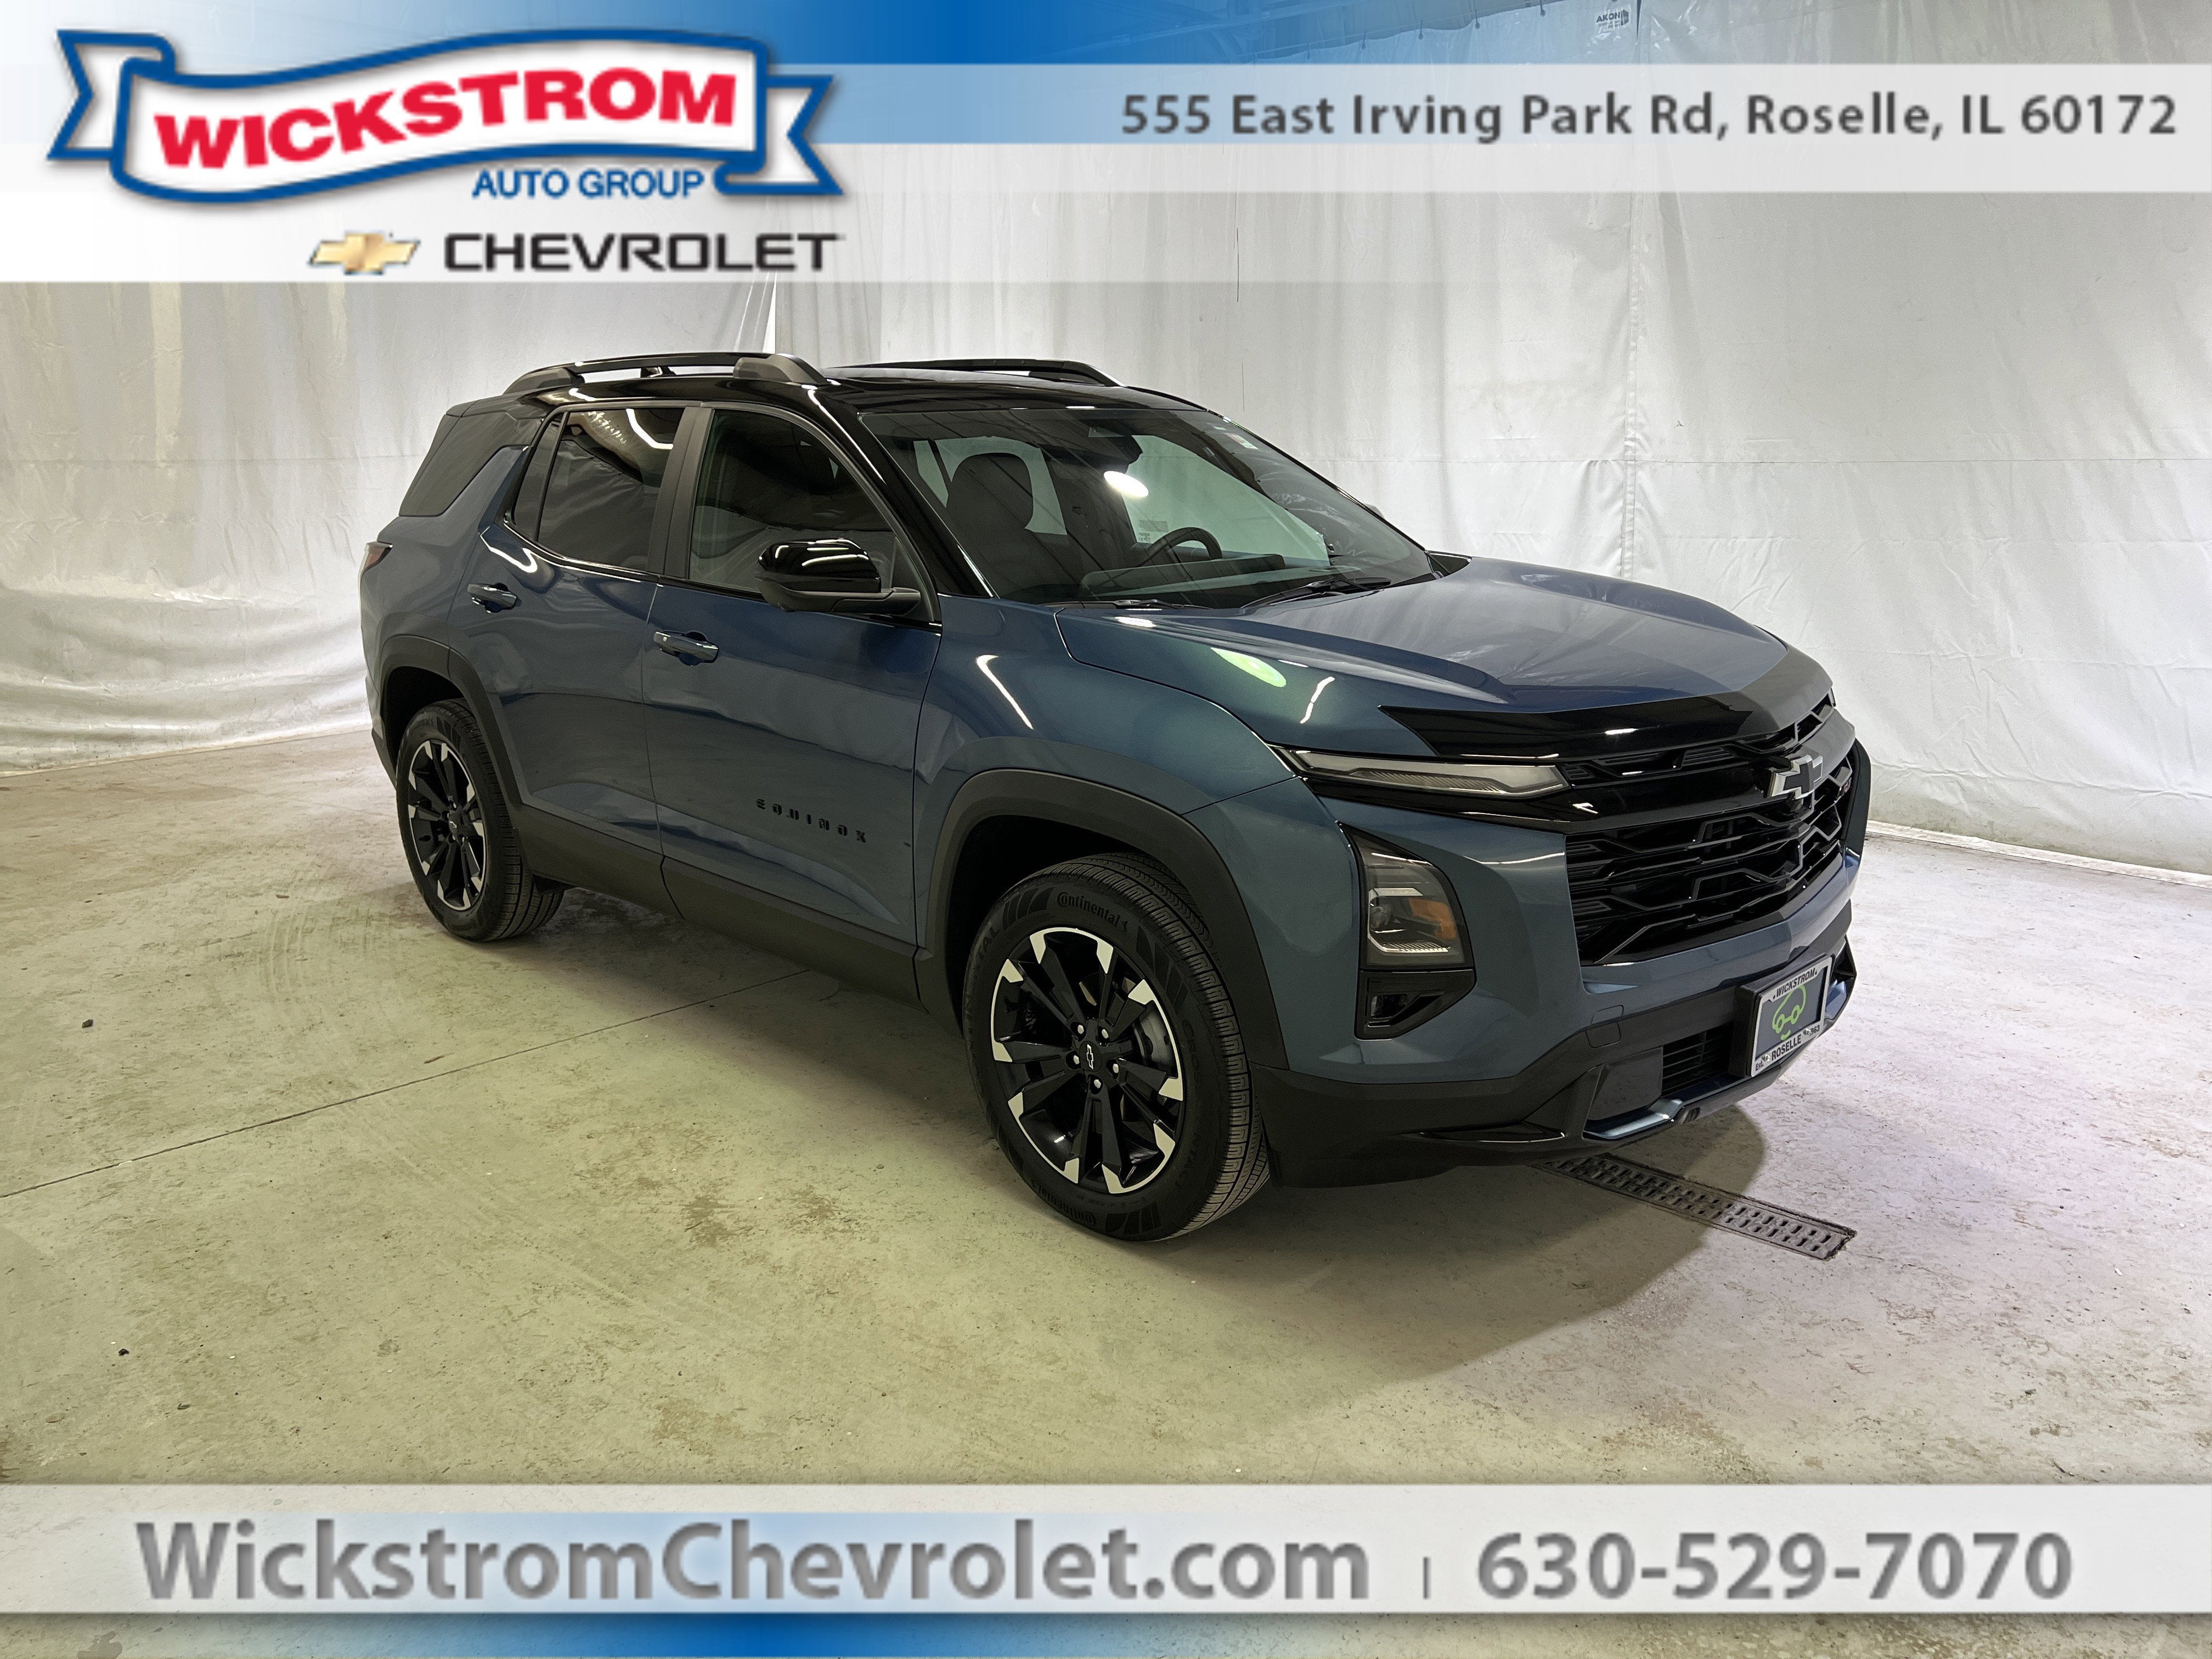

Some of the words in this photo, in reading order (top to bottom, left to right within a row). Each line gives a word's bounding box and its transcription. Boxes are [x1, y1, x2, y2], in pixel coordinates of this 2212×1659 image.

[757, 798, 867, 843] EQUINOX
[1057, 891, 1121, 928] Continental
[1776, 967, 1815, 997] WICKSTROM
[1771, 1034, 1802, 1061] ROSELLE
